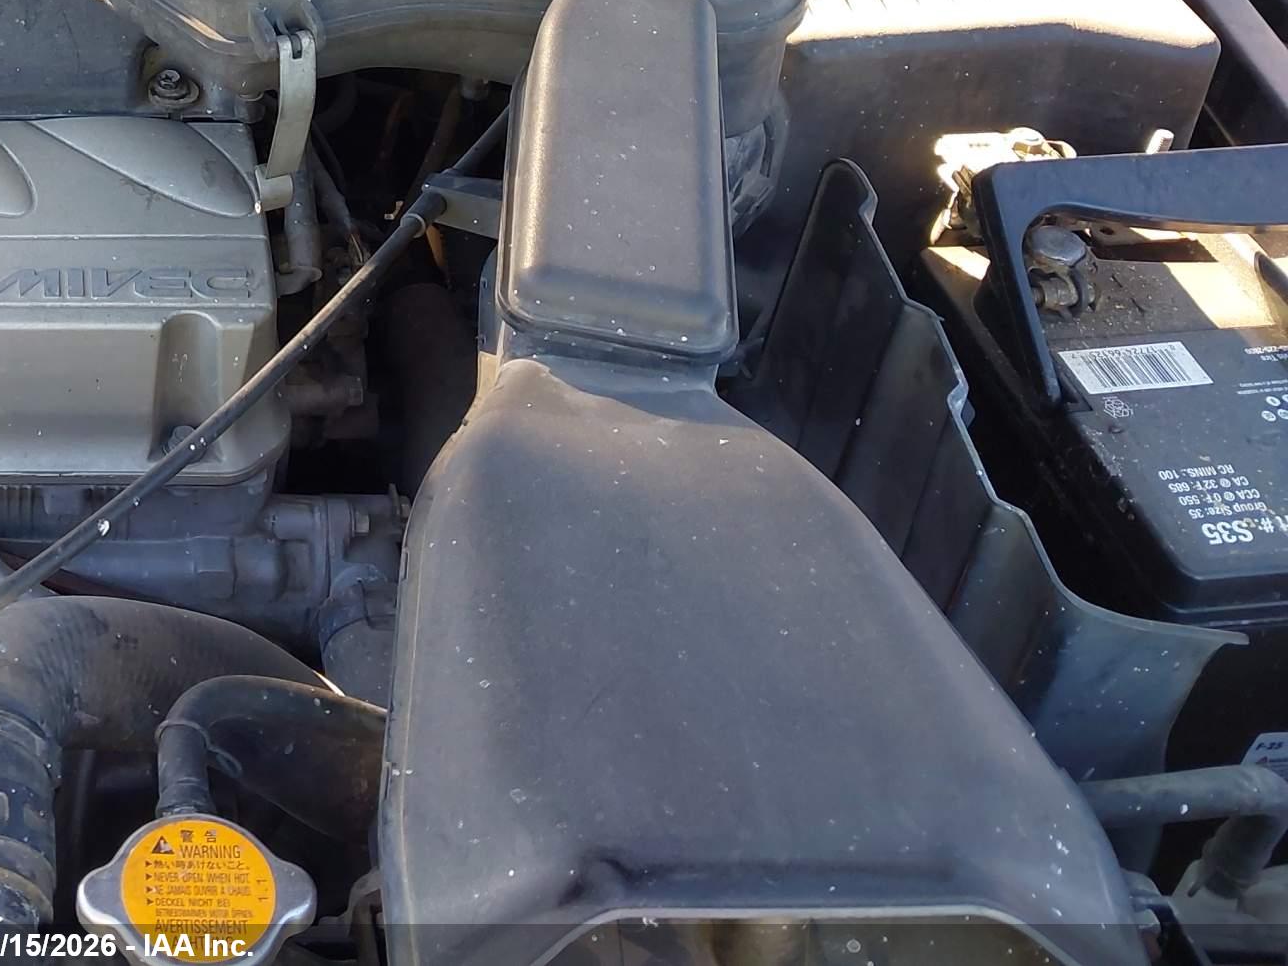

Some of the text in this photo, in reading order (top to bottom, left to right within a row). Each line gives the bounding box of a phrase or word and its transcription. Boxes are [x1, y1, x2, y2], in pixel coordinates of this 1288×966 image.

[1158, 469, 1180, 481] 100
[1217, 464, 1235, 475] RC
[1168, 481, 1191, 493] 685
[1232, 475, 1249, 487] CA
[1178, 494, 1201, 506] 550
[1236, 488, 1261, 500] CCA
[1188, 501, 1268, 519] Group Size: 35
[1201, 519, 1254, 545] S35
[179, 845, 241, 859] WARNING
[154, 872, 180, 882] NEVER
[182, 872, 203, 882] OPEN
[207, 873, 231, 883] WHEN
[155, 897, 184, 907] DECKEL
[188, 898, 213, 907] NICHT
[155, 919, 249, 934] AVERTISSEMENT
